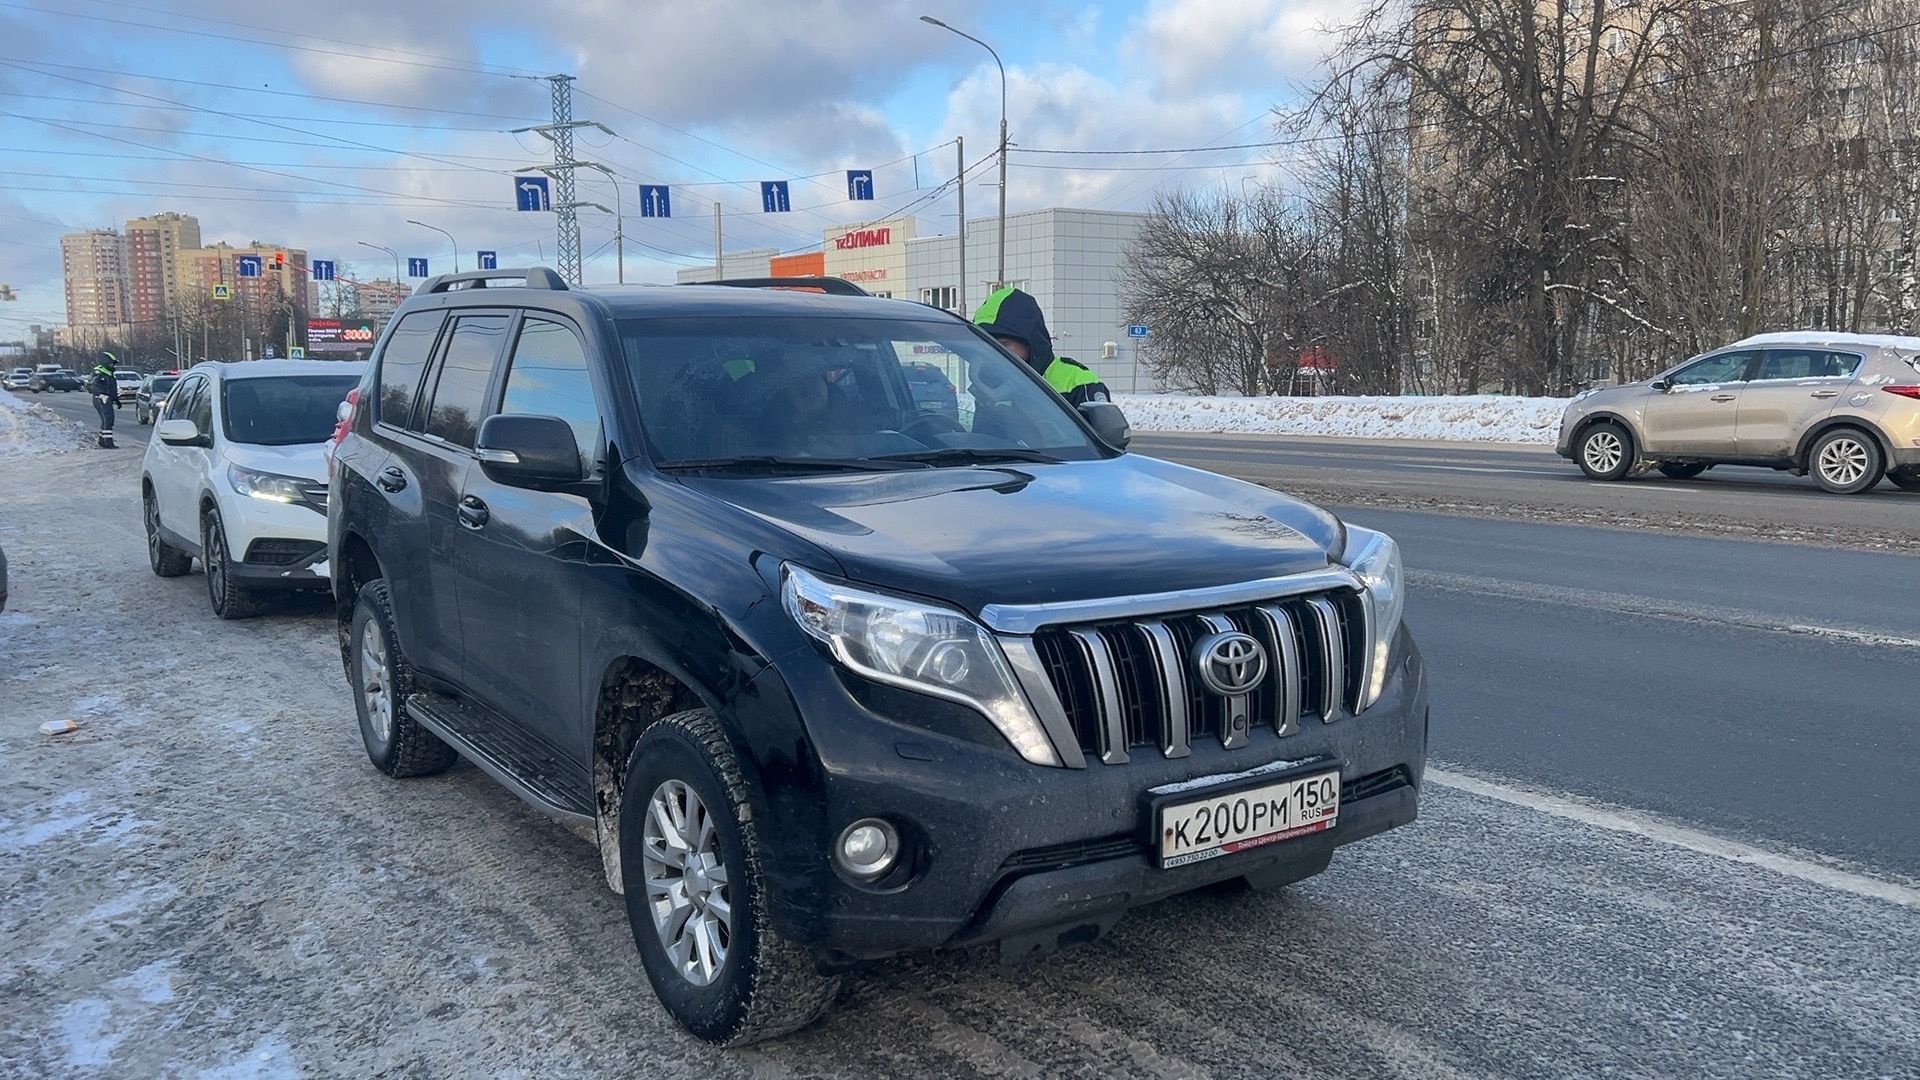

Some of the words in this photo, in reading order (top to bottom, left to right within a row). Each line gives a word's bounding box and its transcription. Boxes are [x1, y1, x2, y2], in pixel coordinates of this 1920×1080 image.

[846, 228, 890, 248] ОЛИМП
[343, 329, 372, 340] 3000
[1174, 797, 1288, 849] К200РМ
[1293, 777, 1333, 810] 150
[1301, 807, 1321, 821] RUS
[1258, 834, 1277, 845] Центр
